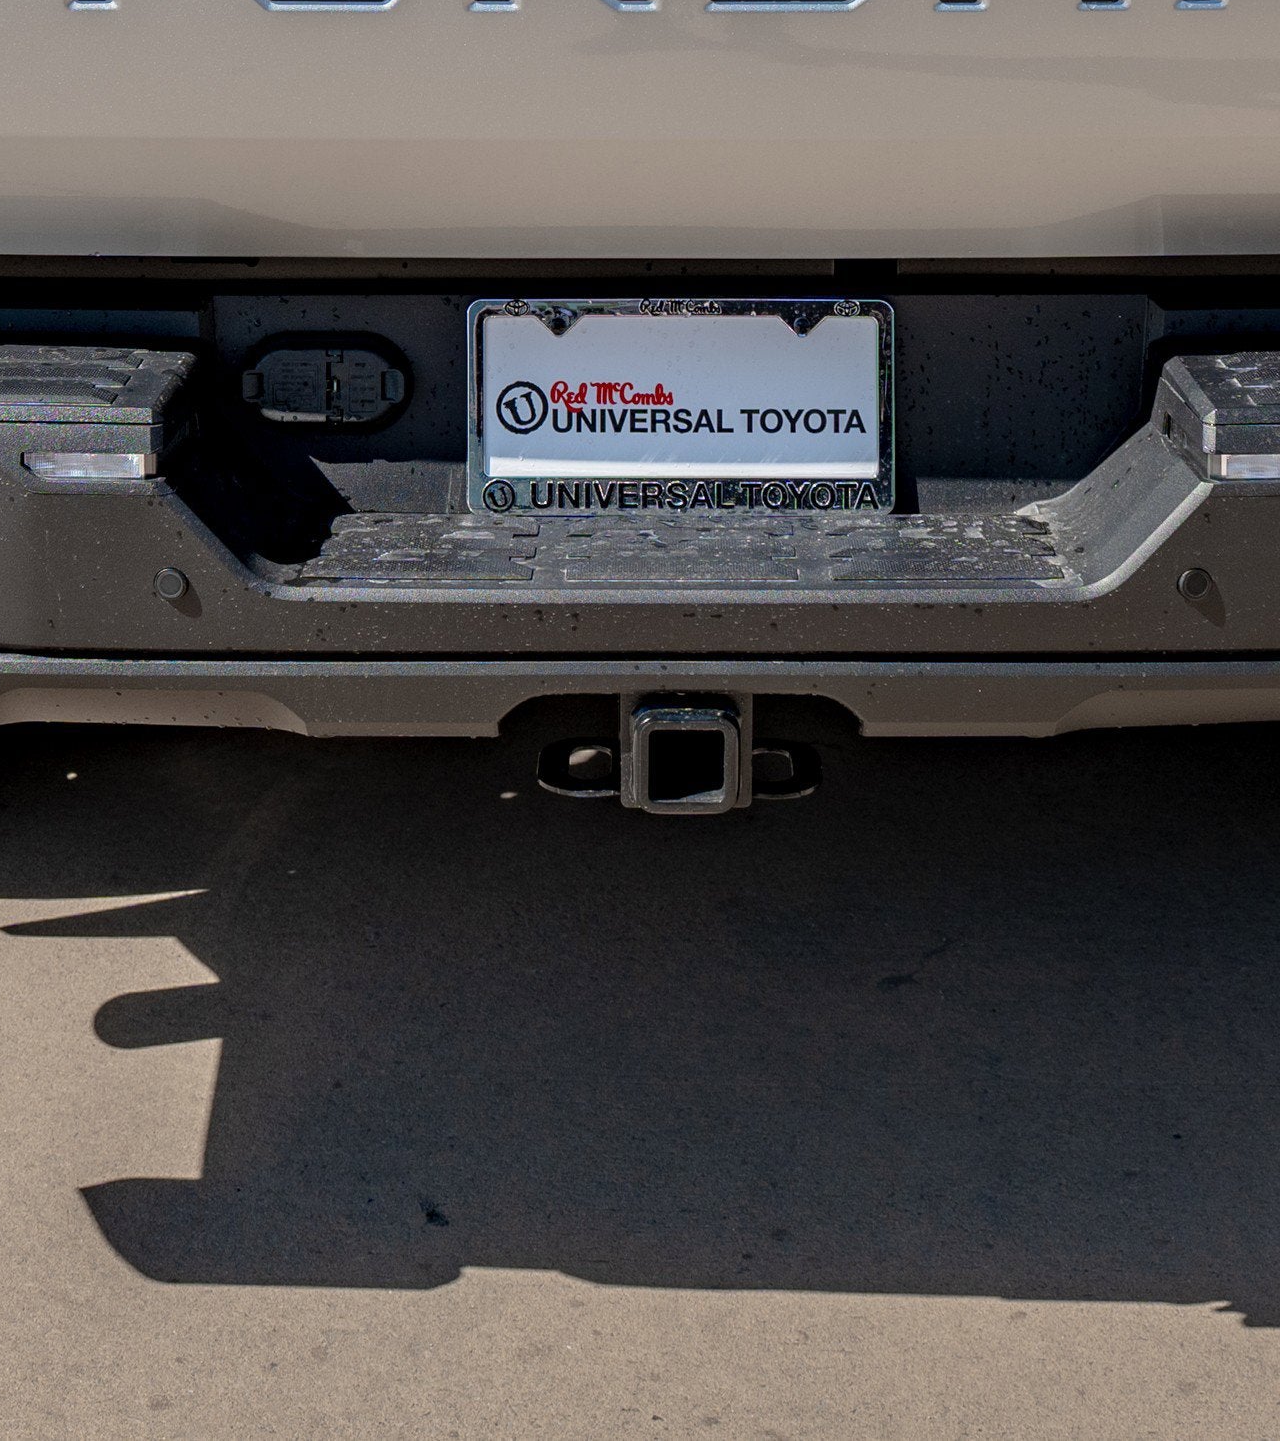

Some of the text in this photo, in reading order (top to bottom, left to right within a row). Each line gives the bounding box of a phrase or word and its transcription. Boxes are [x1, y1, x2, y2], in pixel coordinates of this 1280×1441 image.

[639, 297, 665, 316] Red
[550, 381, 674, 413] Red McCombs
[552, 408, 867, 434] UNIVERSAL TOYOTA
[530, 481, 880, 510] UNIVERSAL TOYOTA
